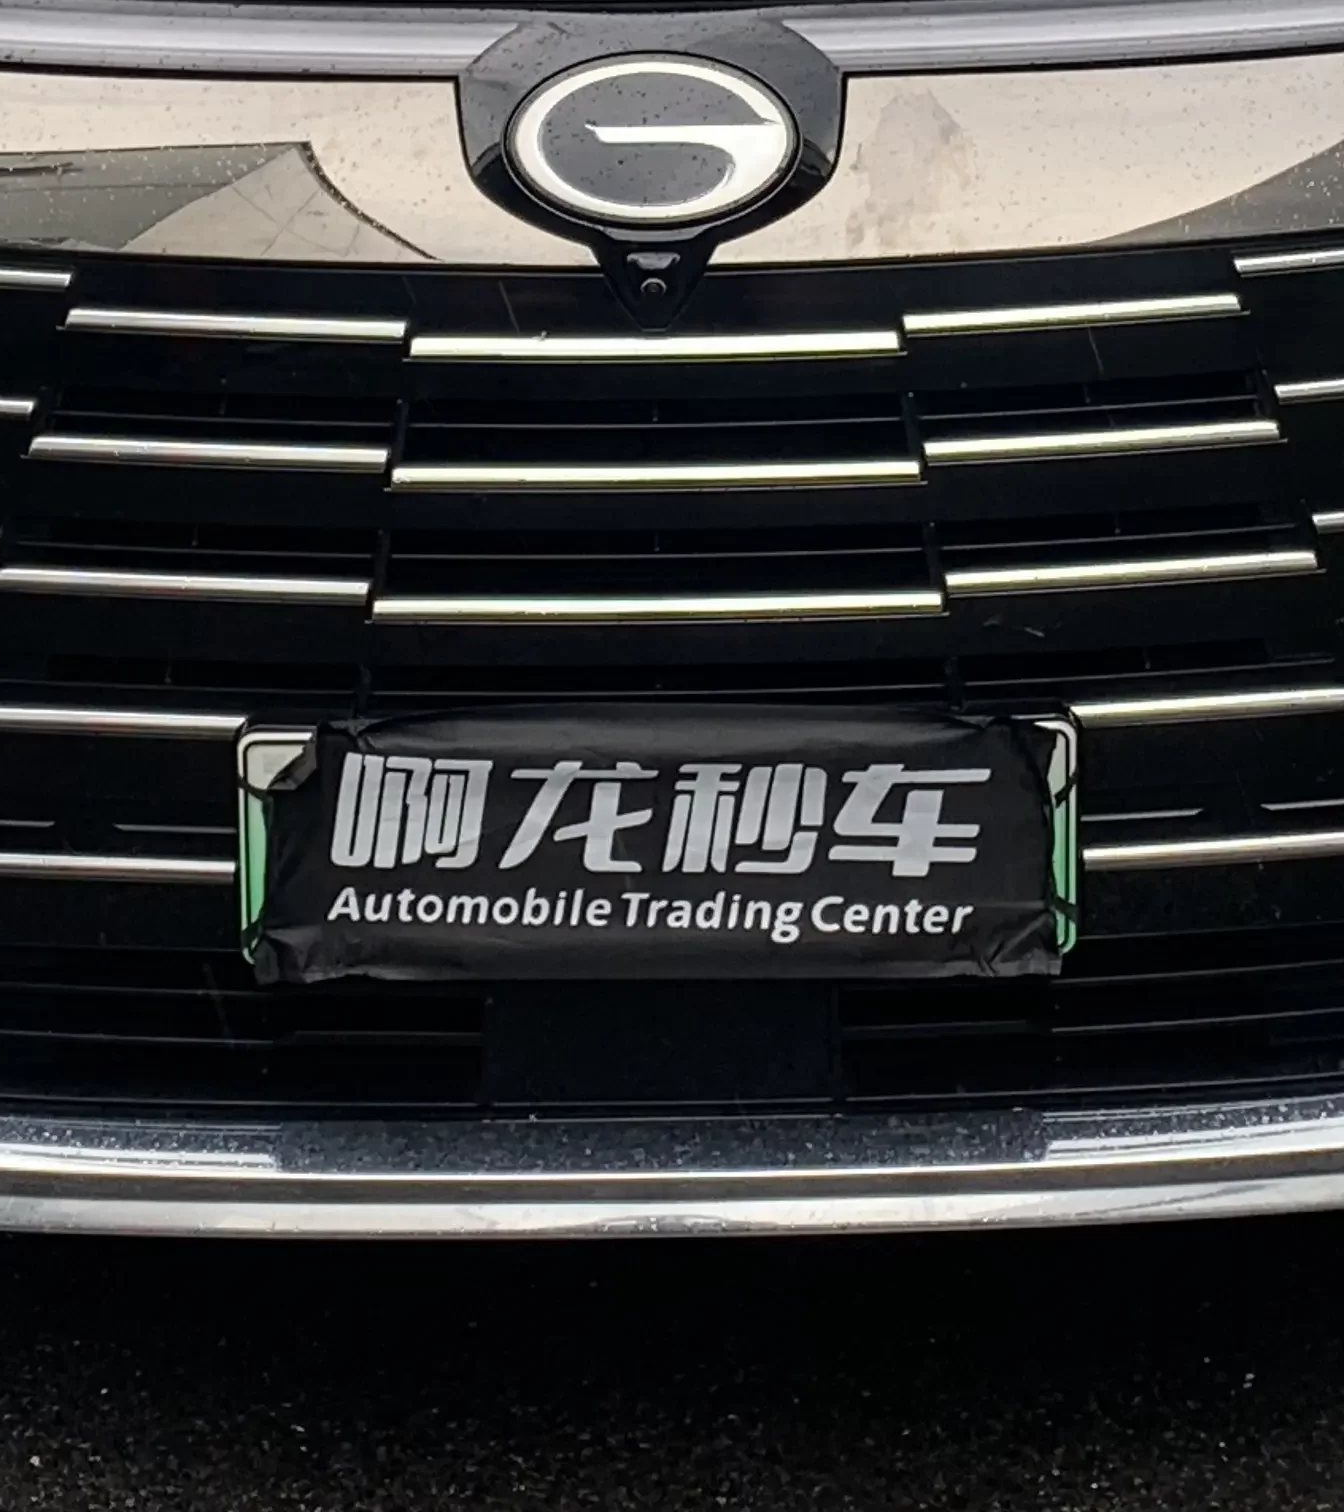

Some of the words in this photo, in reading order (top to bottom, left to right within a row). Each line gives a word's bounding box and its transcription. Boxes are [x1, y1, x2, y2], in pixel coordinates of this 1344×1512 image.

[329, 751, 992, 877] 啊龙秒车
[327, 887, 612, 927] Automobile
[620, 889, 804, 944] Trading
[811, 895, 974, 934] Center
